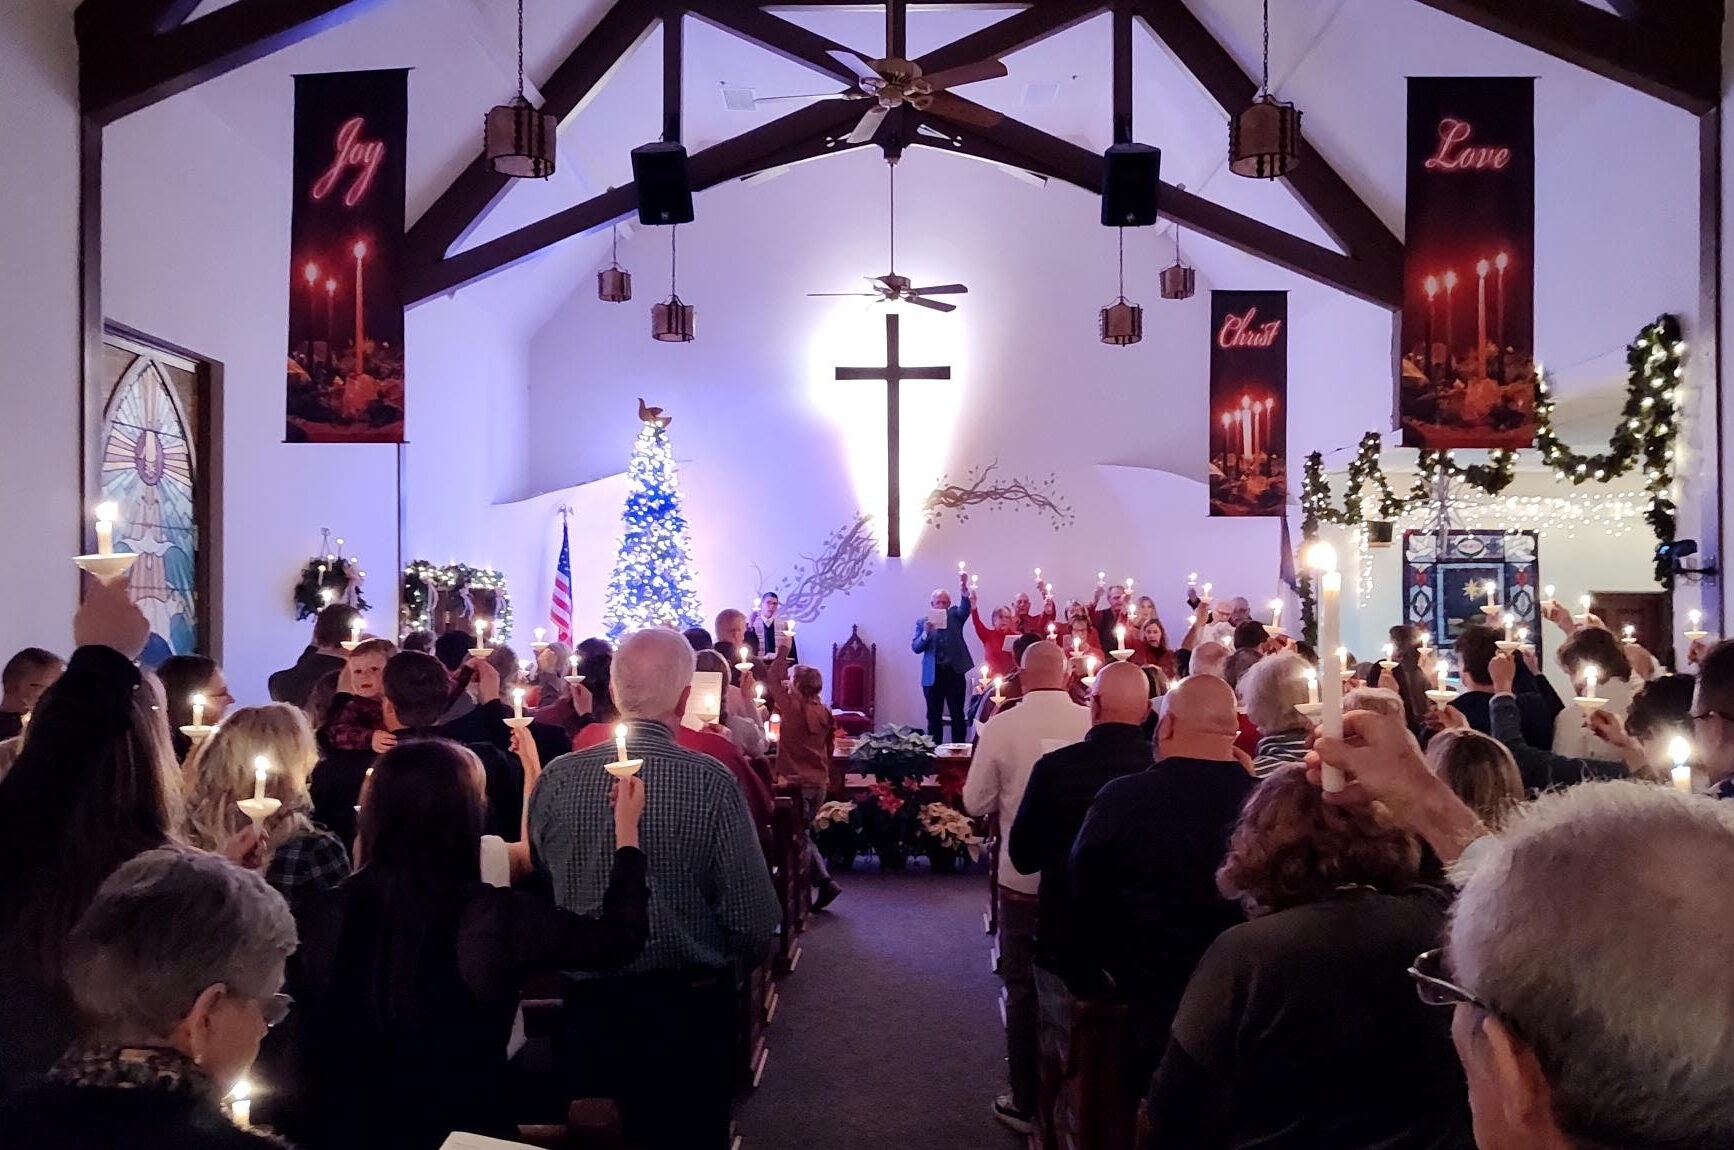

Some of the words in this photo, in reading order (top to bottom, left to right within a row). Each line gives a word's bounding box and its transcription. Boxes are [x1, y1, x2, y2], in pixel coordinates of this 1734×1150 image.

[313, 117, 385, 206] Joy
[1424, 118, 1511, 169] Love
[1219, 306, 1281, 348] Christ
